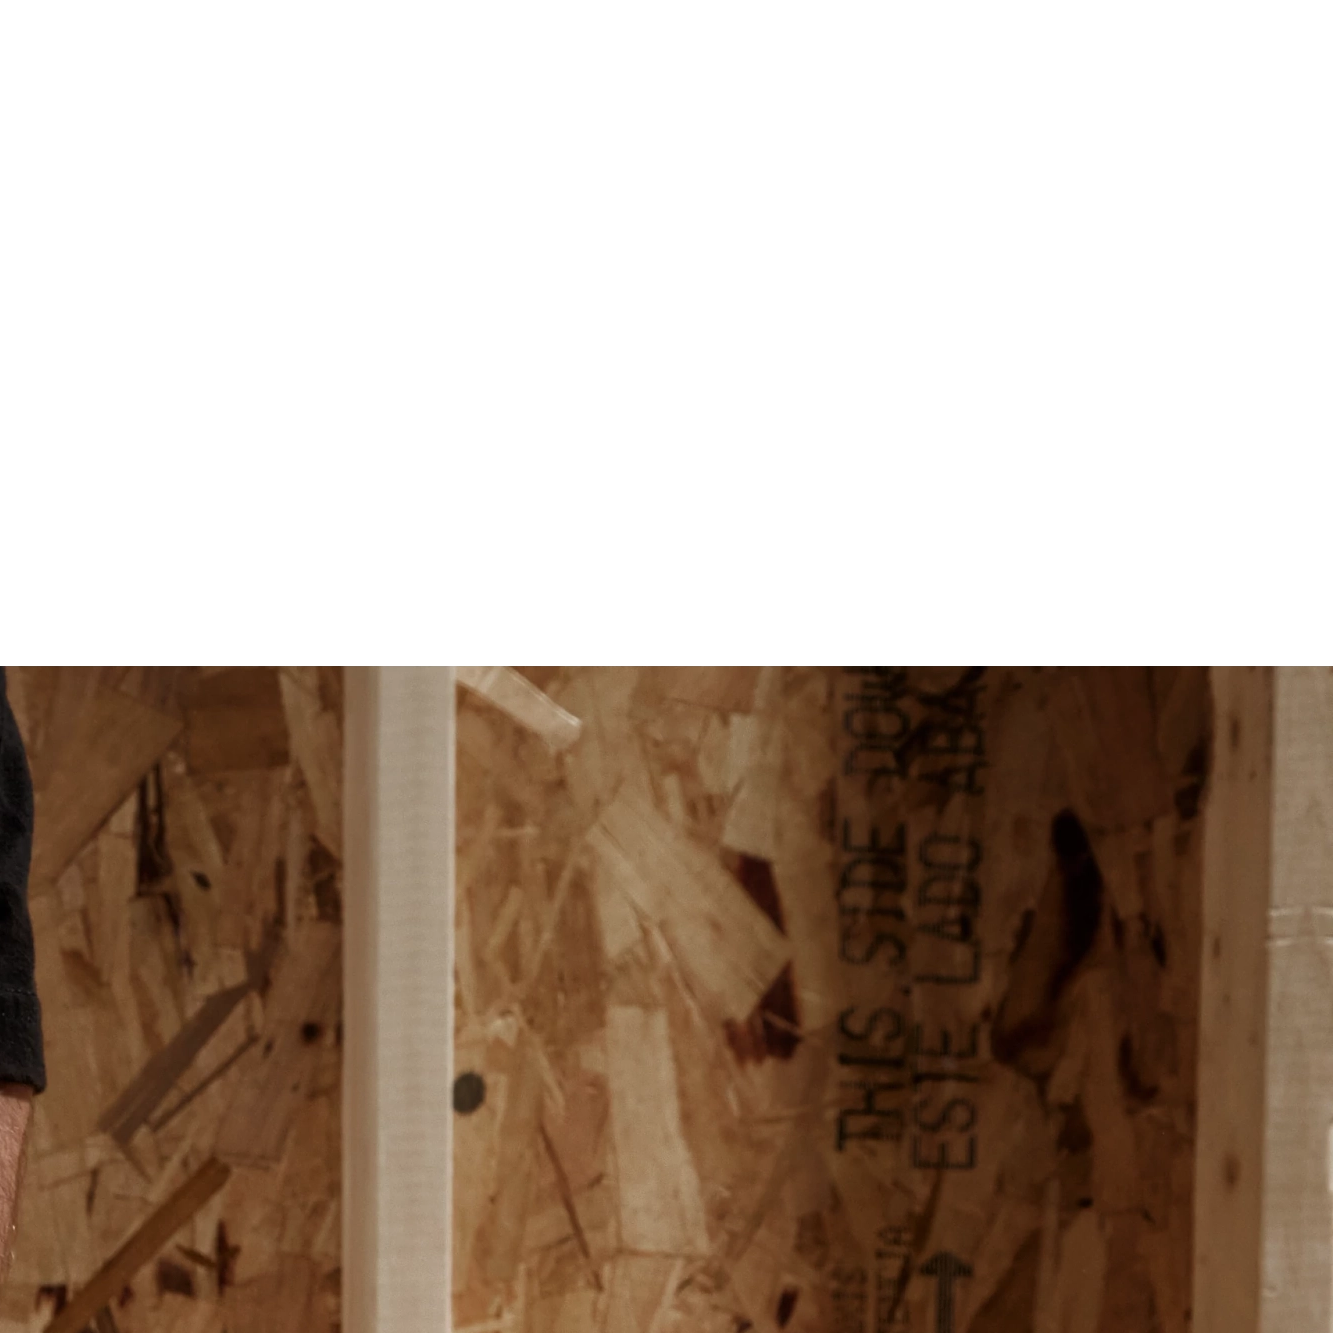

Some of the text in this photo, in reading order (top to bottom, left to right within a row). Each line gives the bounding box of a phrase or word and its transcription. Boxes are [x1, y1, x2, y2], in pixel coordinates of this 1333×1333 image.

[836, 817, 907, 967] SIDE
[913, 832, 983, 985] LADO
[834, 1005, 906, 1153] THIS
[910, 1023, 980, 1171] ESTE
